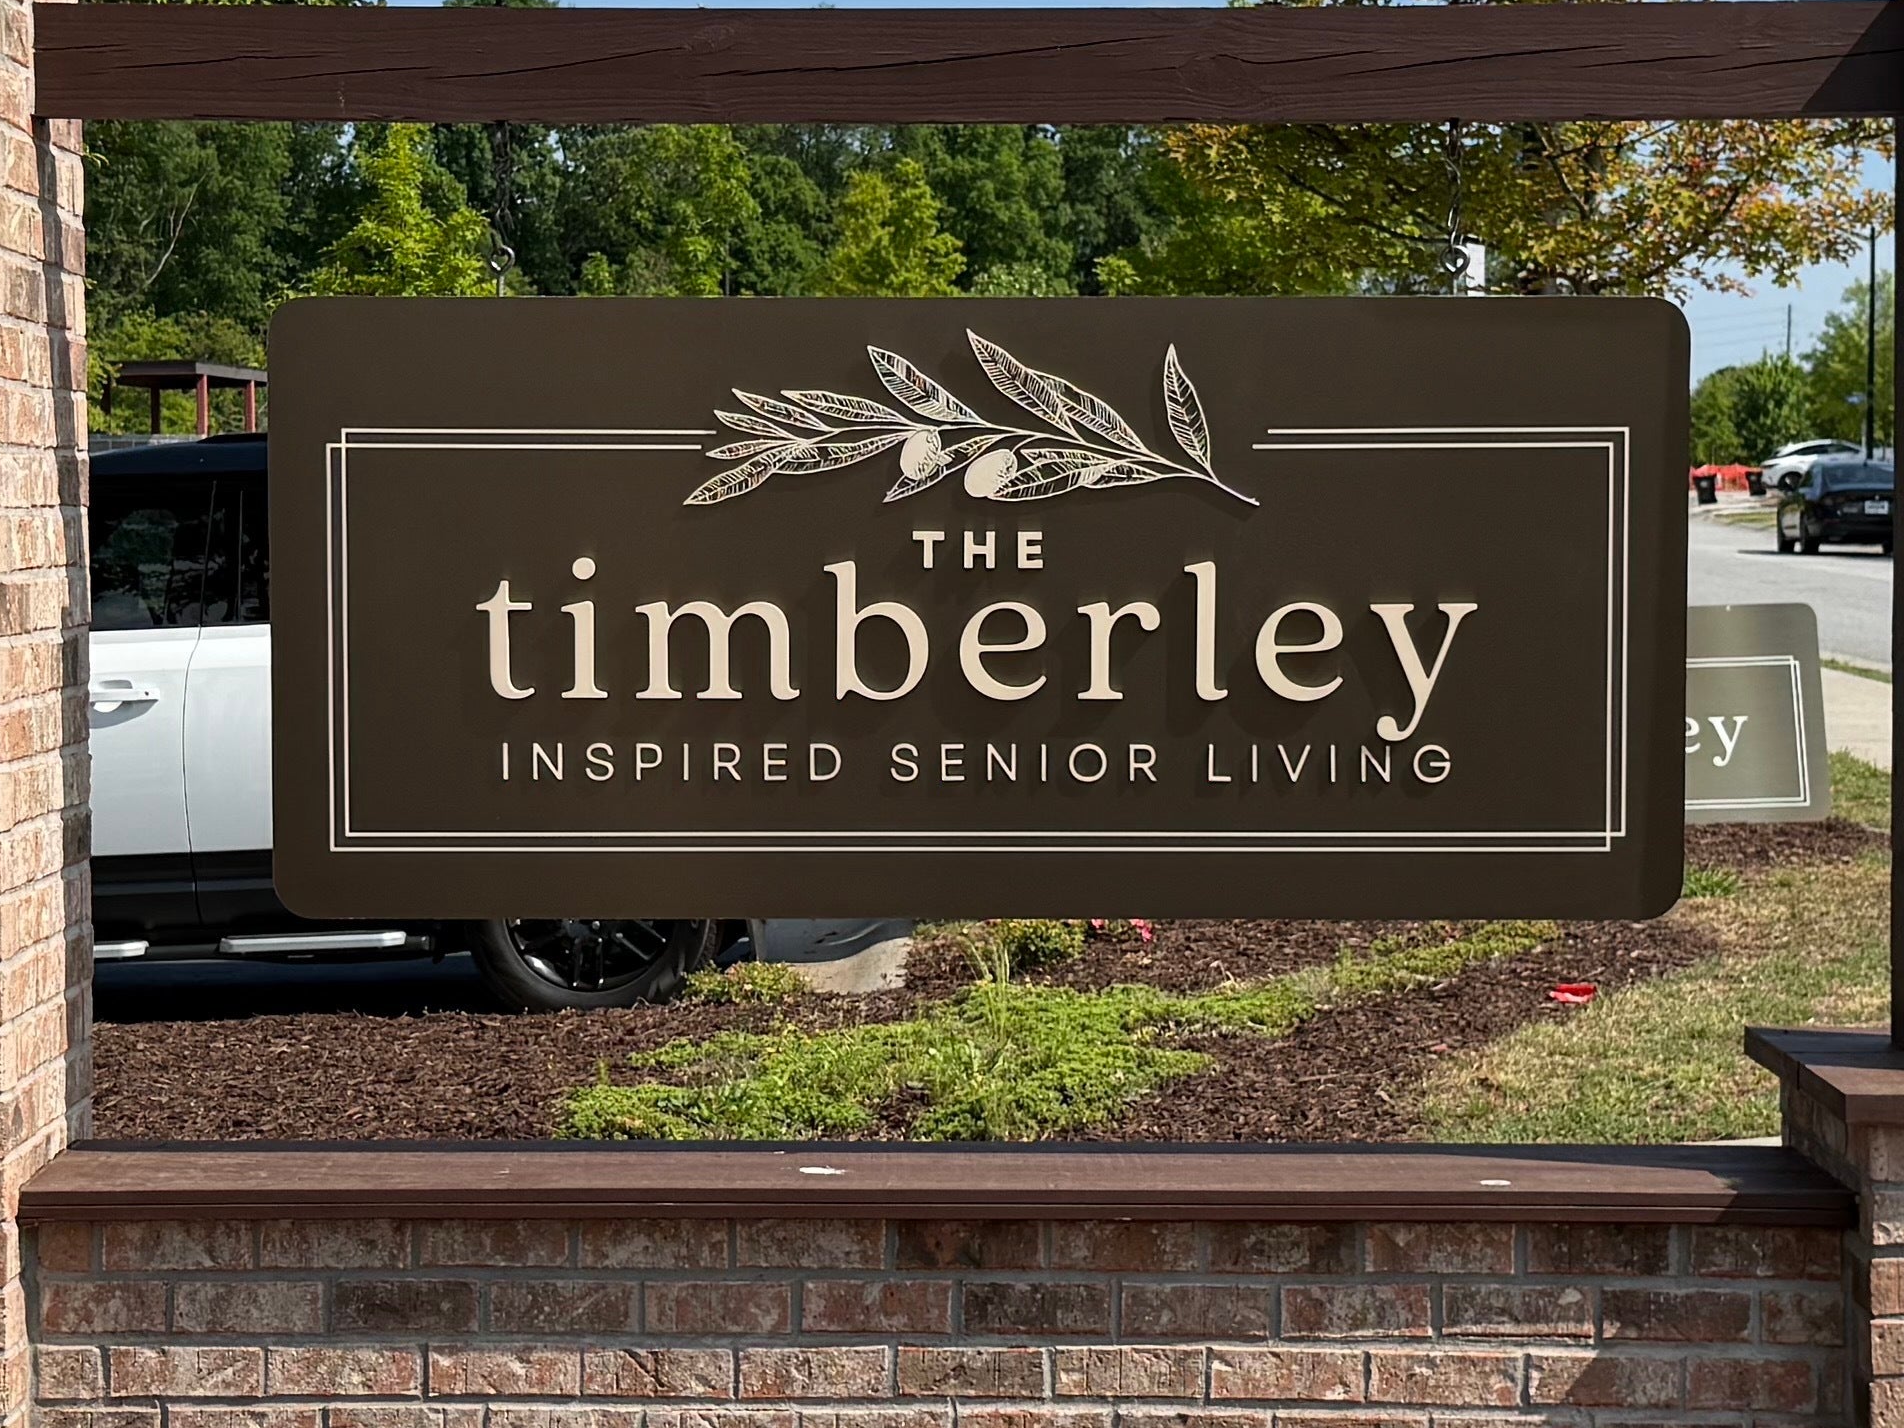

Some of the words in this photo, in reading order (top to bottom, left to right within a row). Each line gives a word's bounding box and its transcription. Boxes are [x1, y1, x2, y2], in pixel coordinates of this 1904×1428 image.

[911, 529, 1046, 570] THE
[474, 555, 1479, 742] timberley
[500, 741, 844, 783] INSPIRED
[888, 741, 1159, 784] SENIOR
[1206, 742, 1454, 785] LIVING
